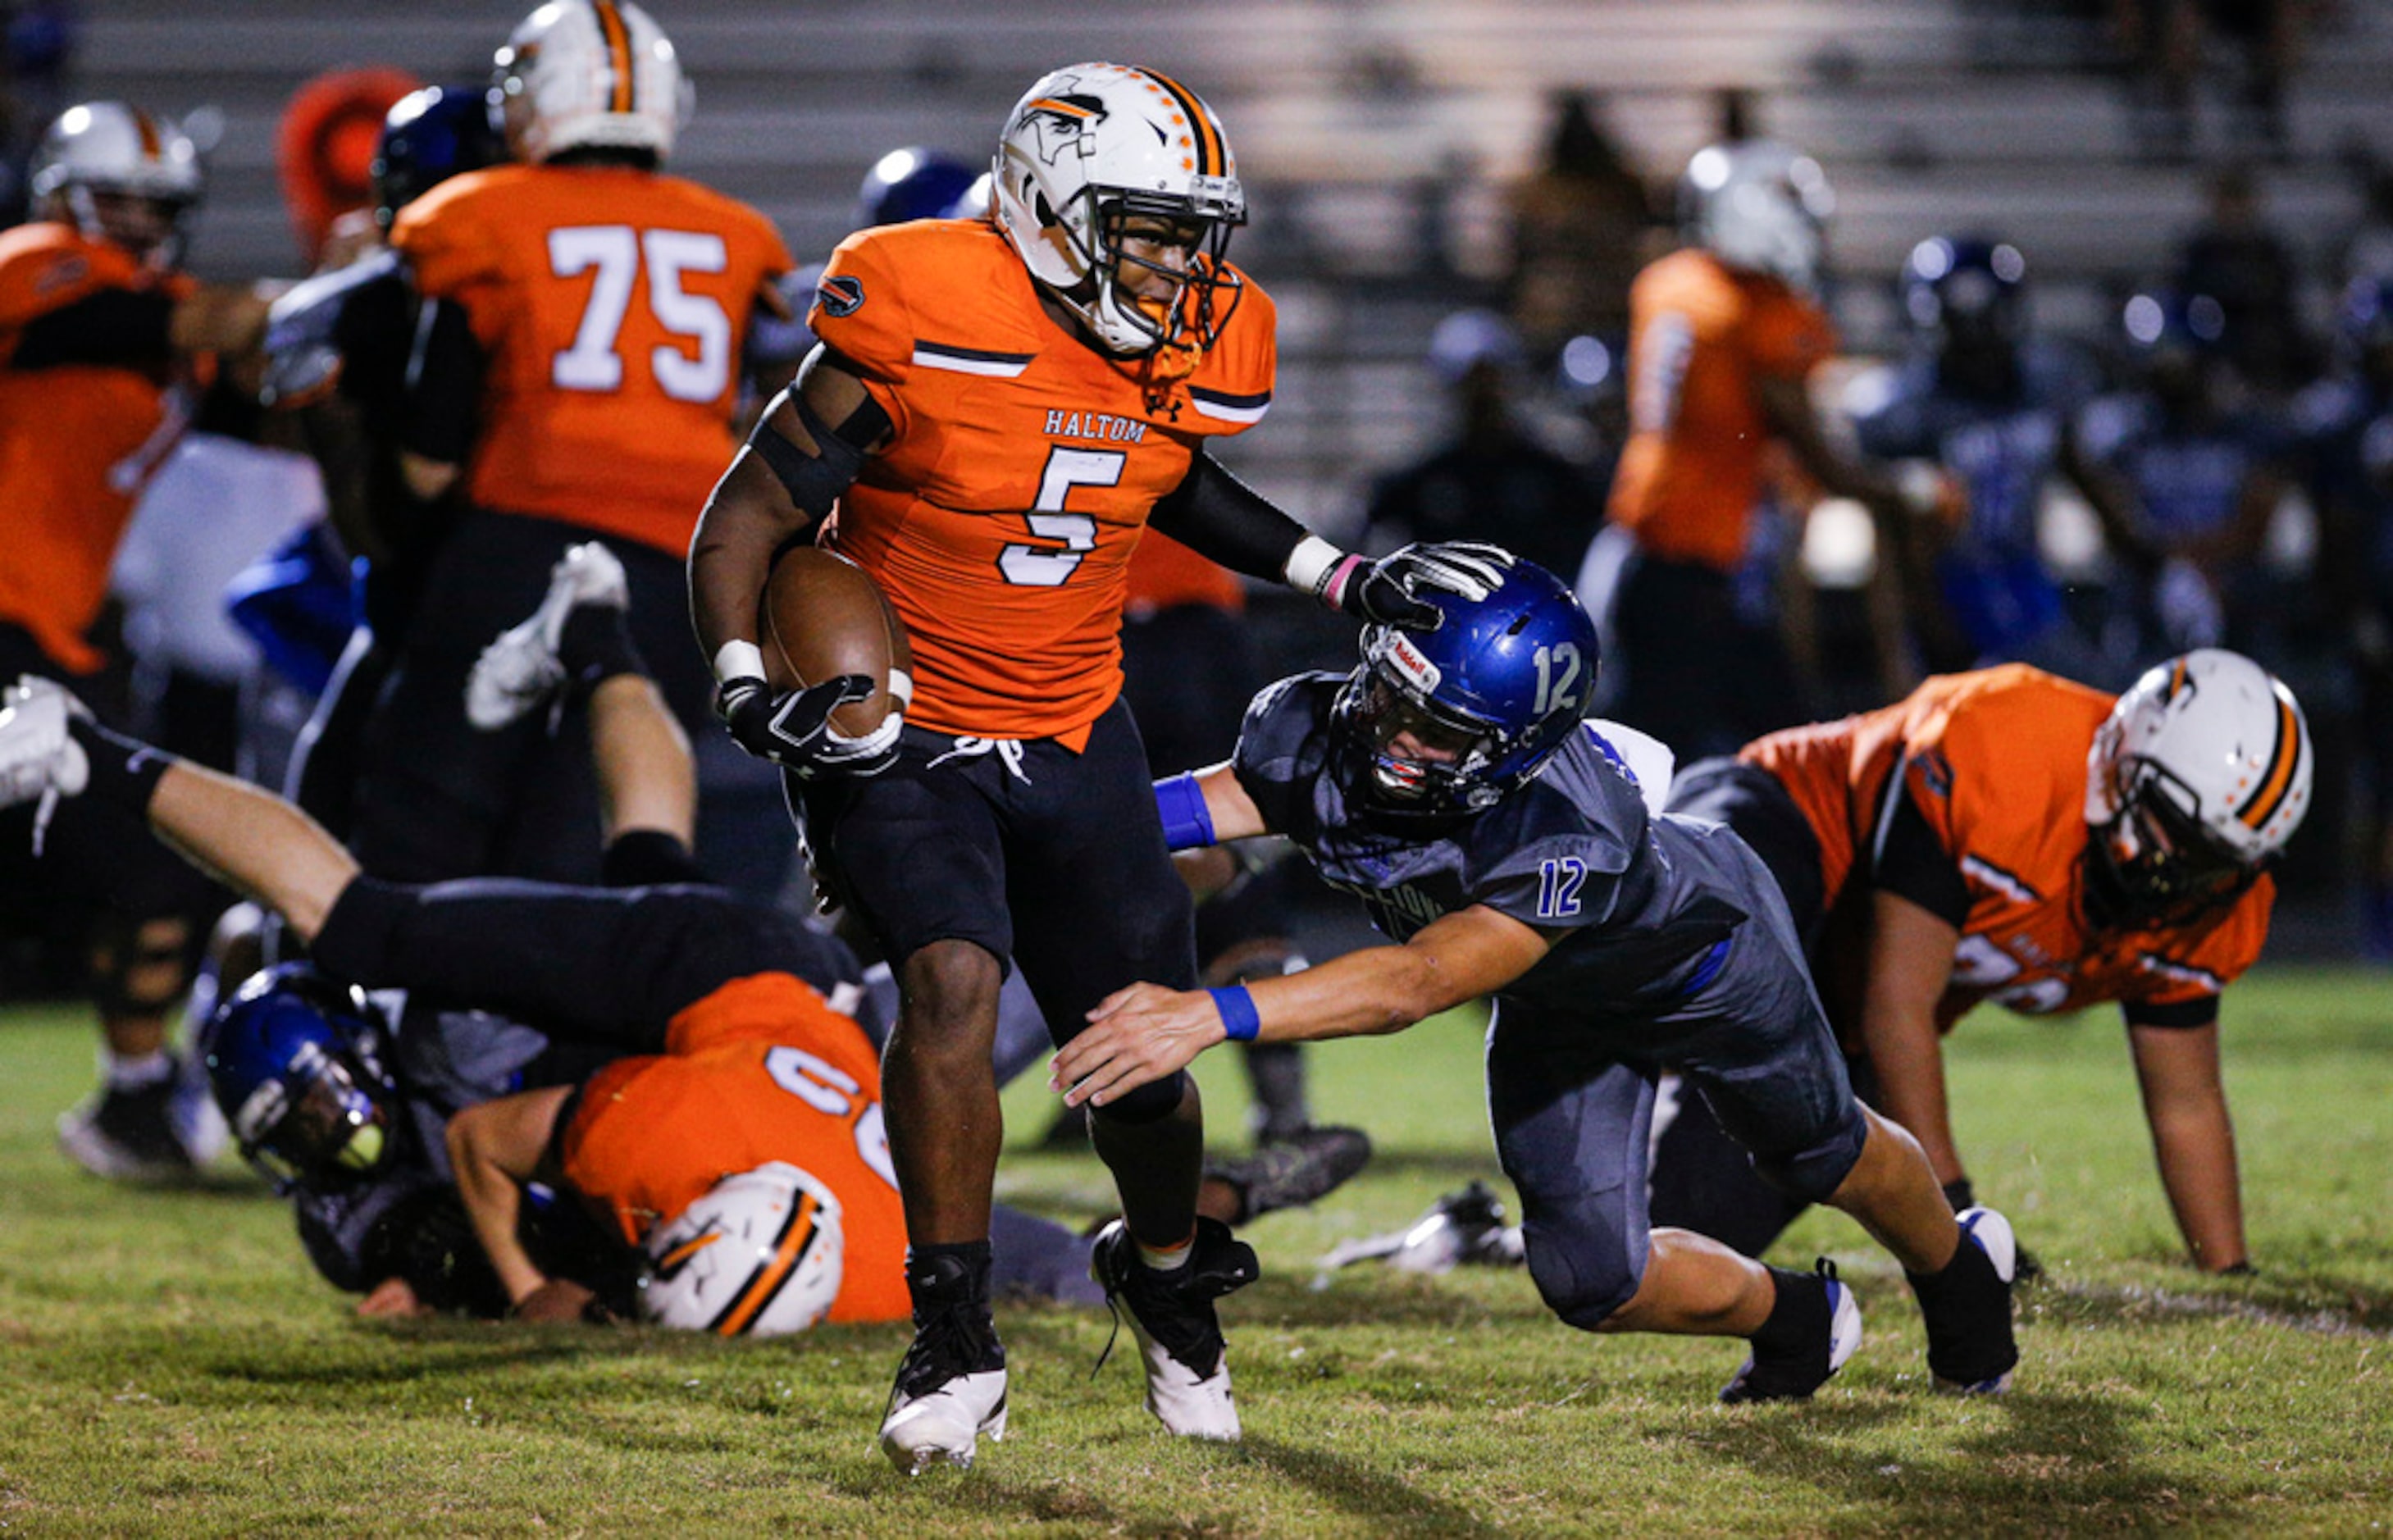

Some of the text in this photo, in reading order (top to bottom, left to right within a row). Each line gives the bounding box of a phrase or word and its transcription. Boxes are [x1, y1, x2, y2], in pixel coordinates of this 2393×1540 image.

[547, 224, 731, 403] 75
[1043, 409, 1146, 443] HALTOM
[996, 444, 1128, 587] 5
[1532, 640, 1582, 715] 12
[1535, 856, 1588, 918] 12
